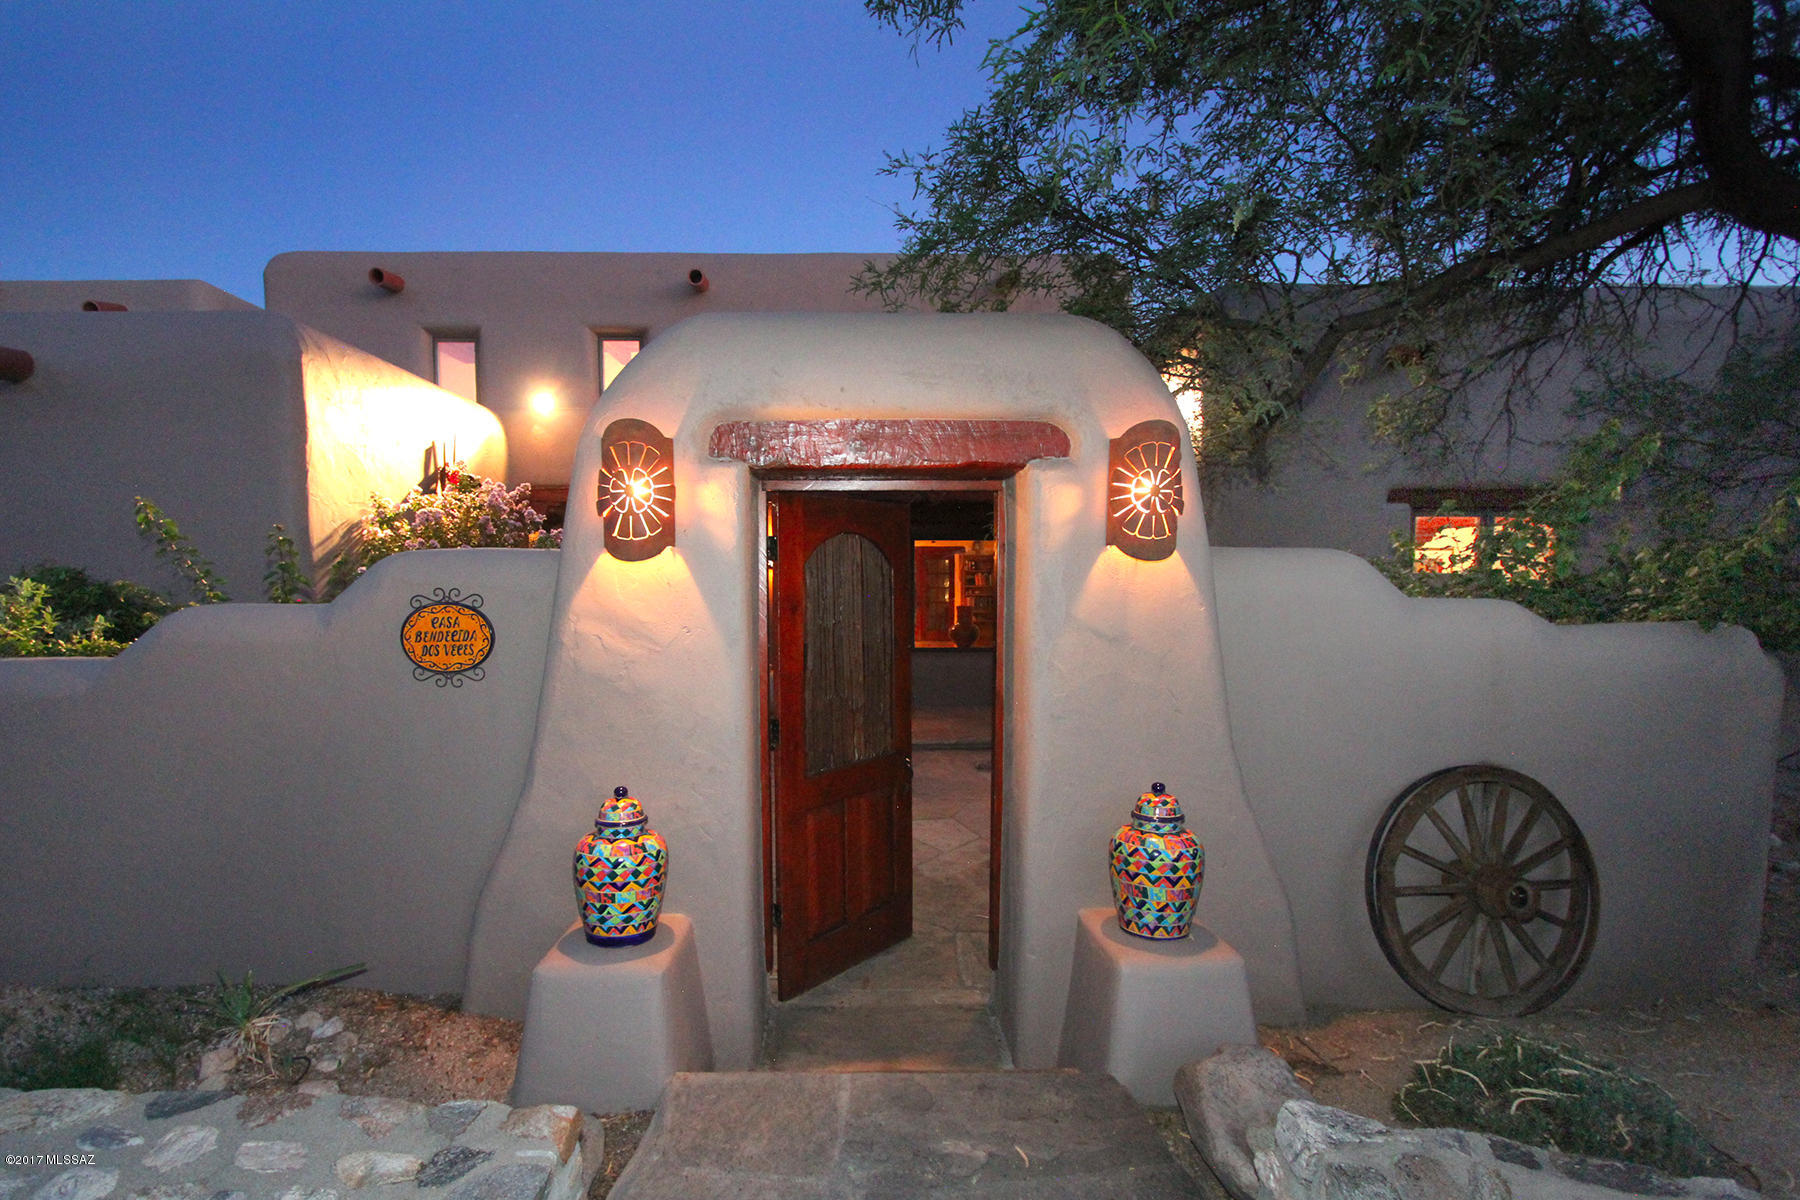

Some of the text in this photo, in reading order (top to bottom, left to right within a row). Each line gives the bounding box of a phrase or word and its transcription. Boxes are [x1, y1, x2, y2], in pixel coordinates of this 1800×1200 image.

[431, 616, 460, 629] CASA
[415, 629, 478, 643] BENDECIDA
[421, 643, 475, 657] DOS VECES
